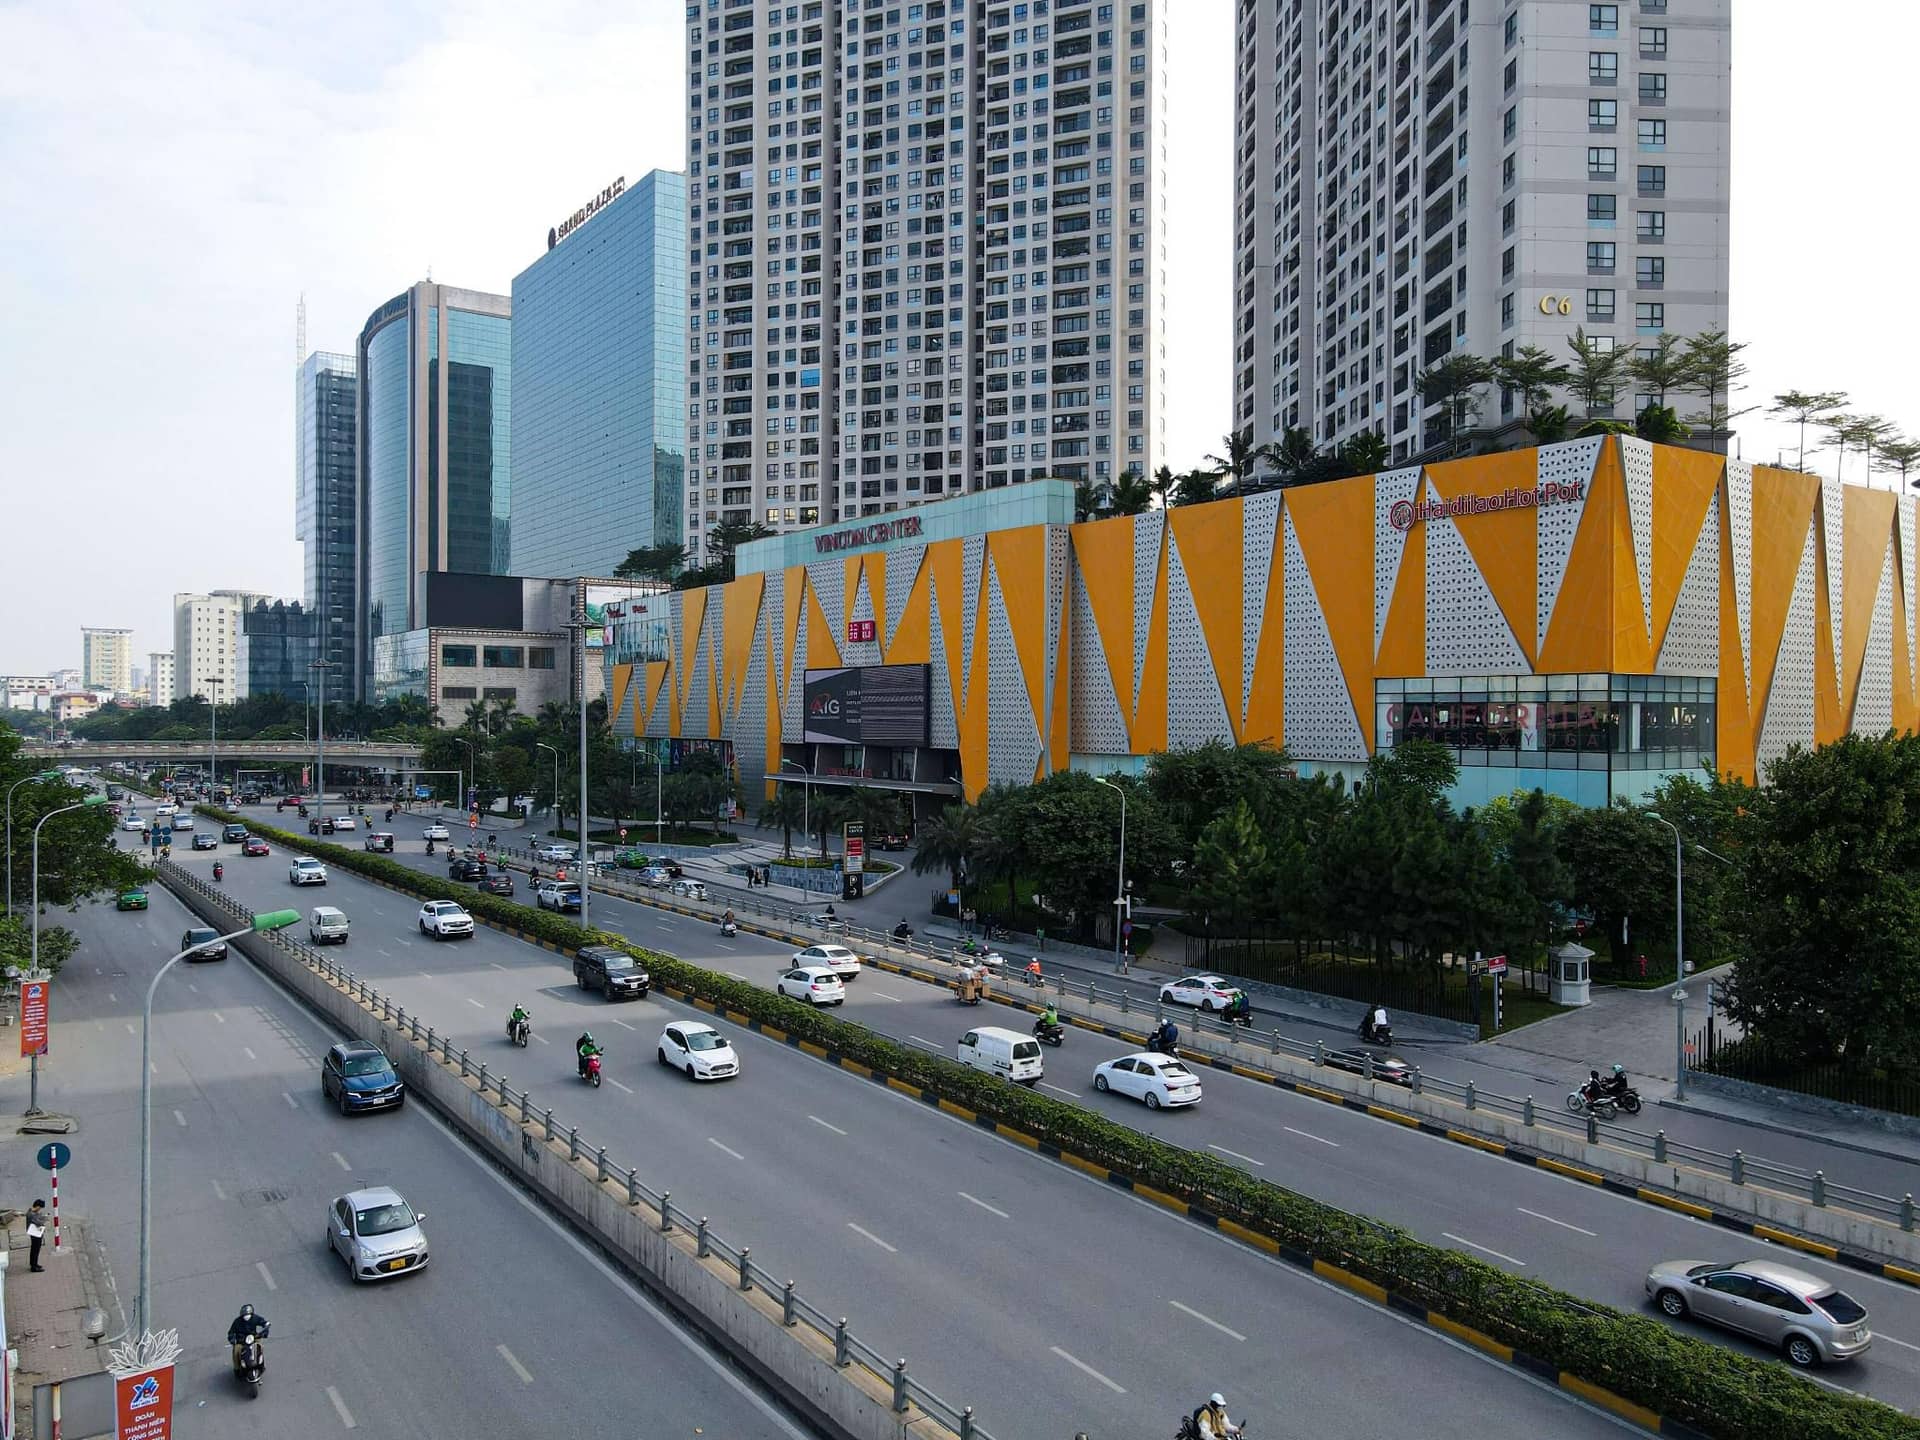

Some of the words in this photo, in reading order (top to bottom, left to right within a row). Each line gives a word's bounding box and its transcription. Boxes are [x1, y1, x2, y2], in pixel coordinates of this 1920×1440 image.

[586, 186, 612, 217] PLAZA
[1539, 295, 1572, 316] C6
[1417, 492, 1500, 520] Haidilao
[1503, 486, 1540, 508] Hot
[1544, 481, 1583, 502] Pot
[814, 526, 866, 553] VINCOM
[867, 515, 924, 544] CENTER
[1386, 703, 1598, 730] CALIFORNIA
[1524, 732, 1599, 747] YOGA
